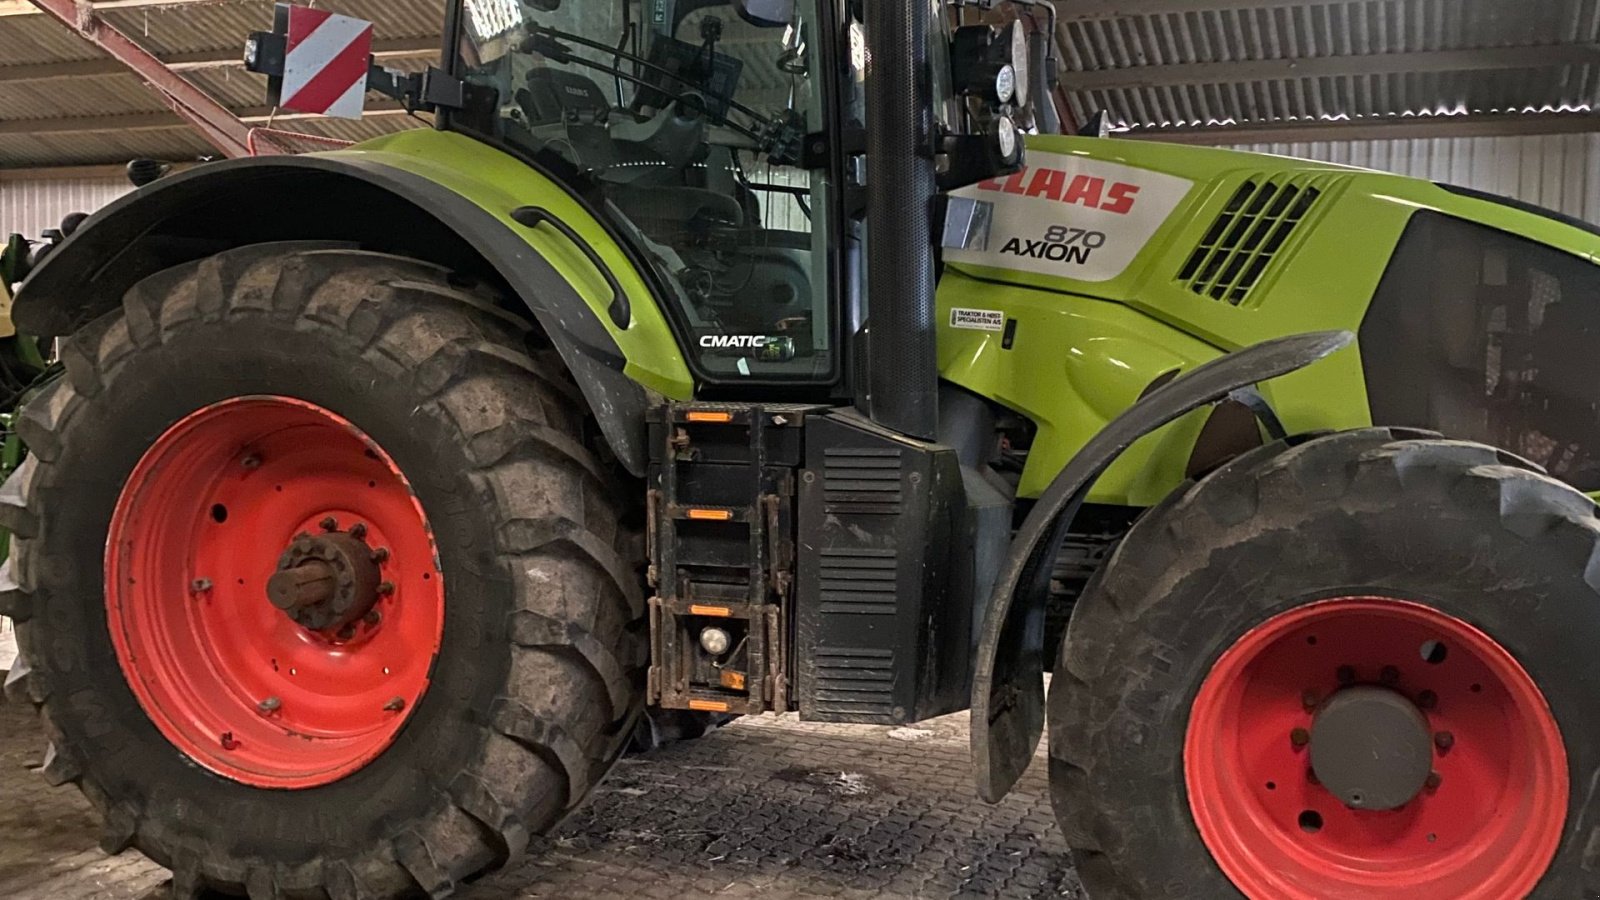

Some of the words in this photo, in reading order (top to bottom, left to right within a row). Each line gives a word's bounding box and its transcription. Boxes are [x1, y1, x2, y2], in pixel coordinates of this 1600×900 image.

[1044, 225, 1106, 248] 870
[1000, 237, 1091, 264] AXION
[699, 335, 766, 347] CMATIC
